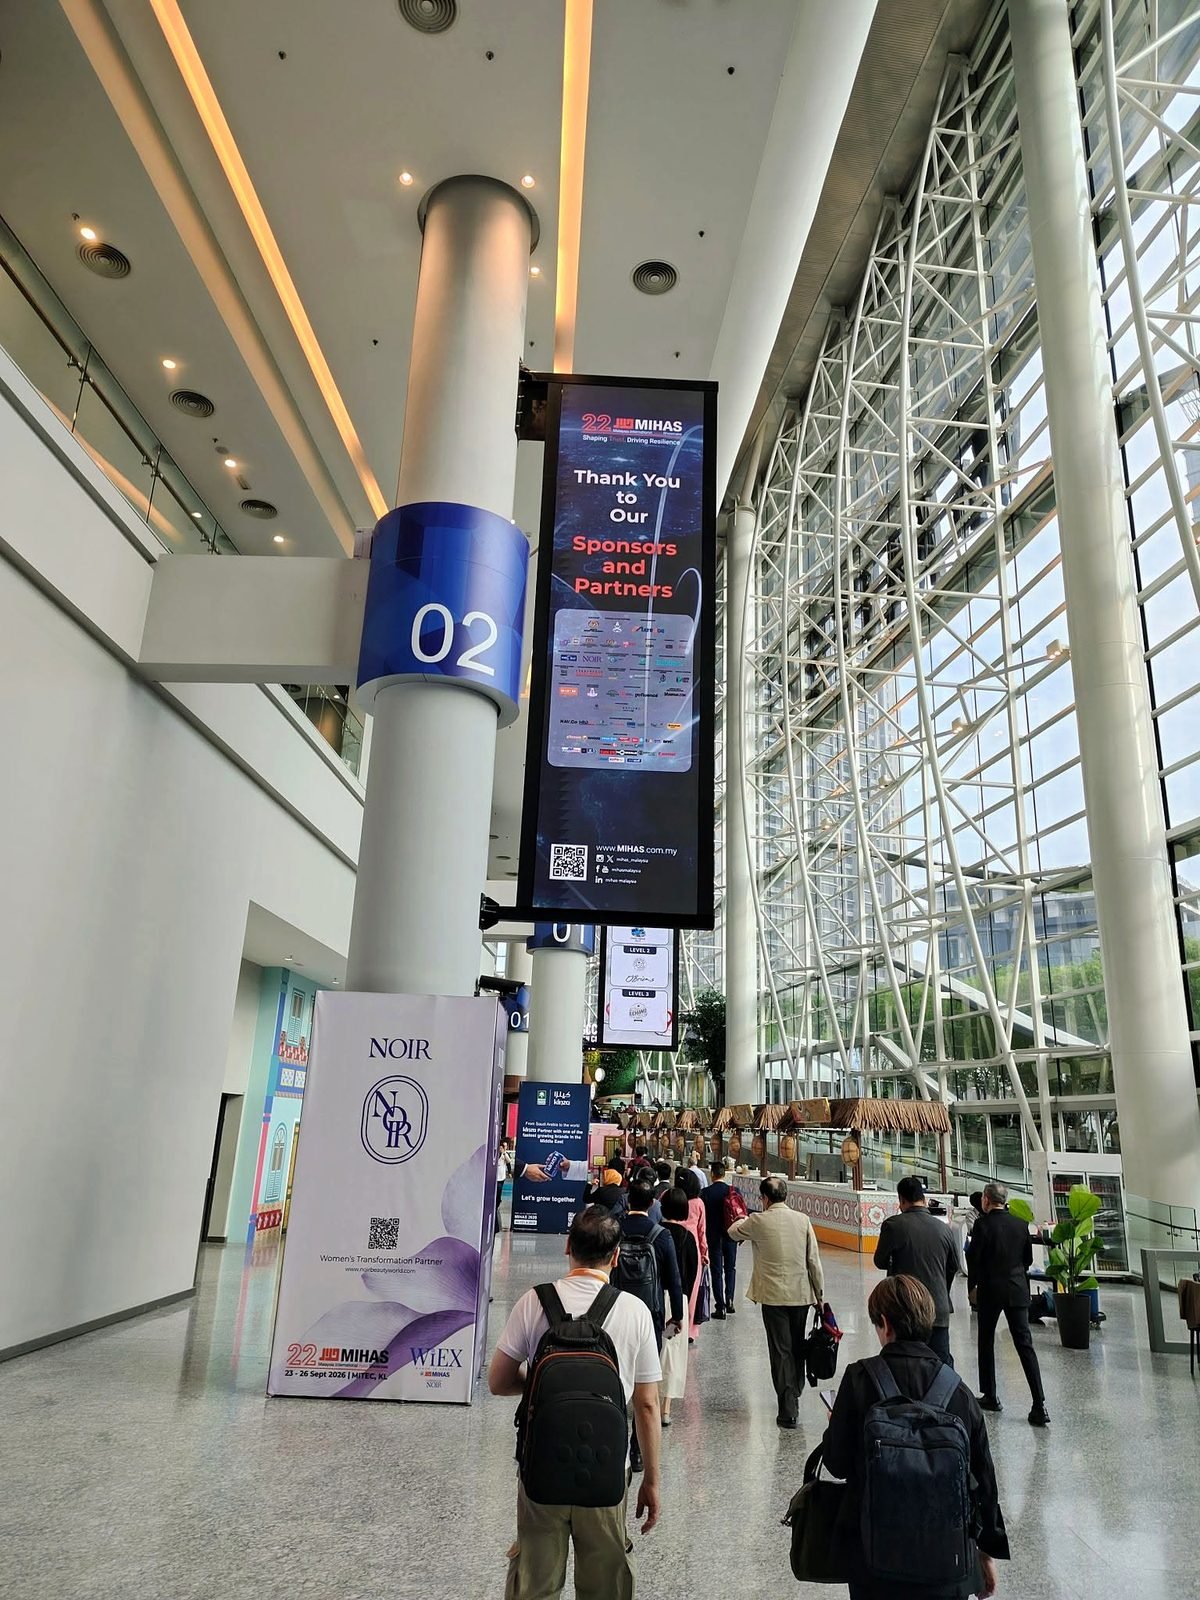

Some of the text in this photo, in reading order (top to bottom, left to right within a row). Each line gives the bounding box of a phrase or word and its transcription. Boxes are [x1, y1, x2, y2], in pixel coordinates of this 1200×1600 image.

[581, 413, 611, 432] 22
[634, 419, 682, 432] MIHAS
[582, 435, 608, 443] Shaping
[626, 437, 649, 445] Driving
[649, 438, 681, 446] Resilience
[573, 469, 681, 490] Thank You
[616, 490, 637, 505] to
[609, 508, 649, 524] Our
[572, 535, 677, 556] Sponsors
[602, 559, 645, 575] and
[574, 577, 673, 599] Partners
[411, 603, 498, 677] 02
[596, 844, 678, 857] www.MIHAS.com.my
[510, 1011, 530, 1029] 01
[368, 1037, 433, 1060] NOIR
[319, 1254, 444, 1266] Women's Transformation Partner
[344, 1266, 416, 1275] www.noirbeautyworld.com
[286, 1343, 318, 1366] 22
[340, 1348, 390, 1364] MIHAS
[410, 1347, 463, 1369] WiEX
[310, 1370, 327, 1379] Sept
[328, 1371, 346, 1379] 2026
[351, 1371, 377, 1380] MITEC,
